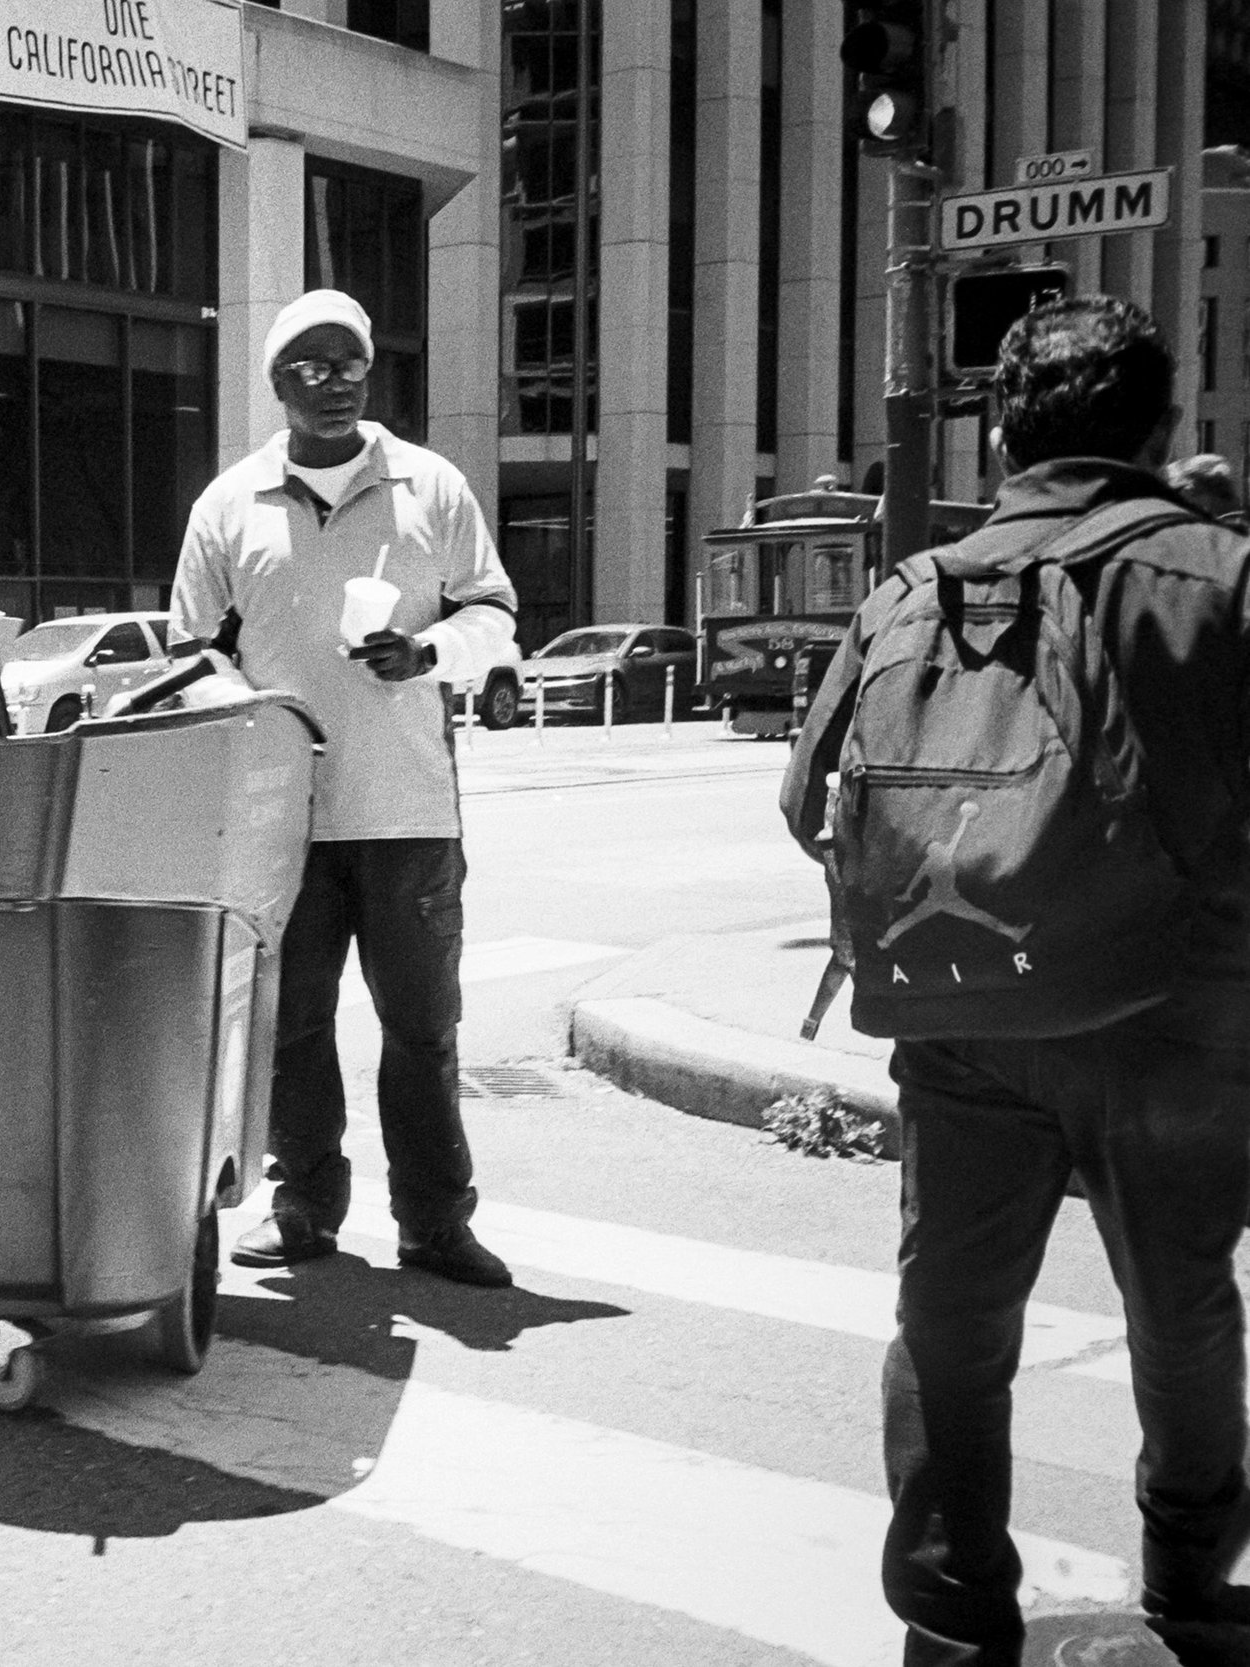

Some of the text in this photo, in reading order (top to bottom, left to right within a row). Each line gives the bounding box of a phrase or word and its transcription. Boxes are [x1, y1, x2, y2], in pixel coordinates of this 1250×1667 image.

[104, 0, 155, 40] ONE
[7, 26, 167, 89] CALIFORNIA
[1025, 157, 1066, 180] 000
[955, 181, 1153, 240] DRUMM
[892, 951, 1033, 985] AIR
